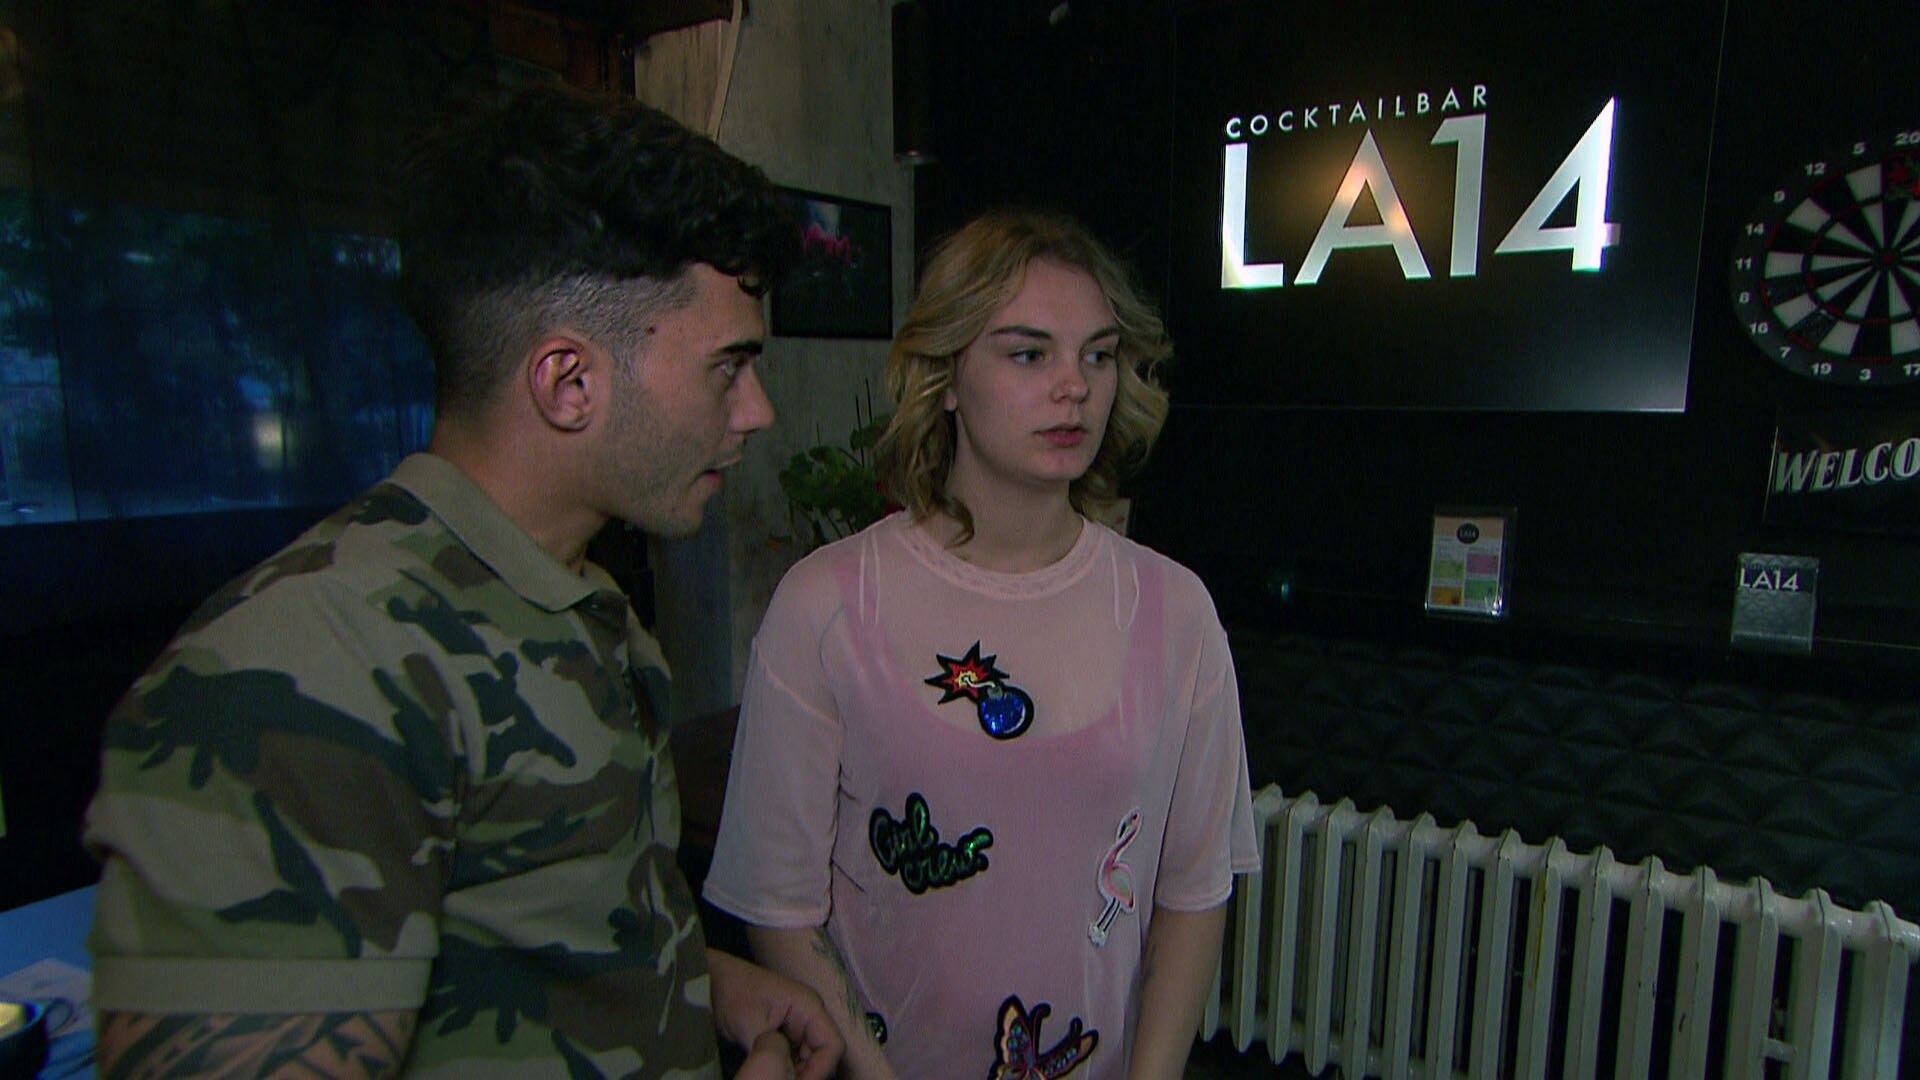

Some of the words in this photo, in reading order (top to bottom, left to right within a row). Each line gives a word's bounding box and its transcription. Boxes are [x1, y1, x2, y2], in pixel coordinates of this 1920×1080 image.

[1225, 84, 1487, 138] COCKTAILBAR
[1852, 142, 1866, 155] 5
[1805, 162, 1826, 177] 12
[1221, 96, 1620, 289] LA14
[1773, 190, 1786, 204] 9
[1745, 222, 1765, 236] 14
[1735, 257, 1752, 271] 11
[1749, 321, 1768, 334] 16
[1780, 346, 1792, 359] 7
[1811, 361, 1832, 375] 19
[1858, 368, 1871, 381] 3
[1740, 567, 1800, 592] LA14
